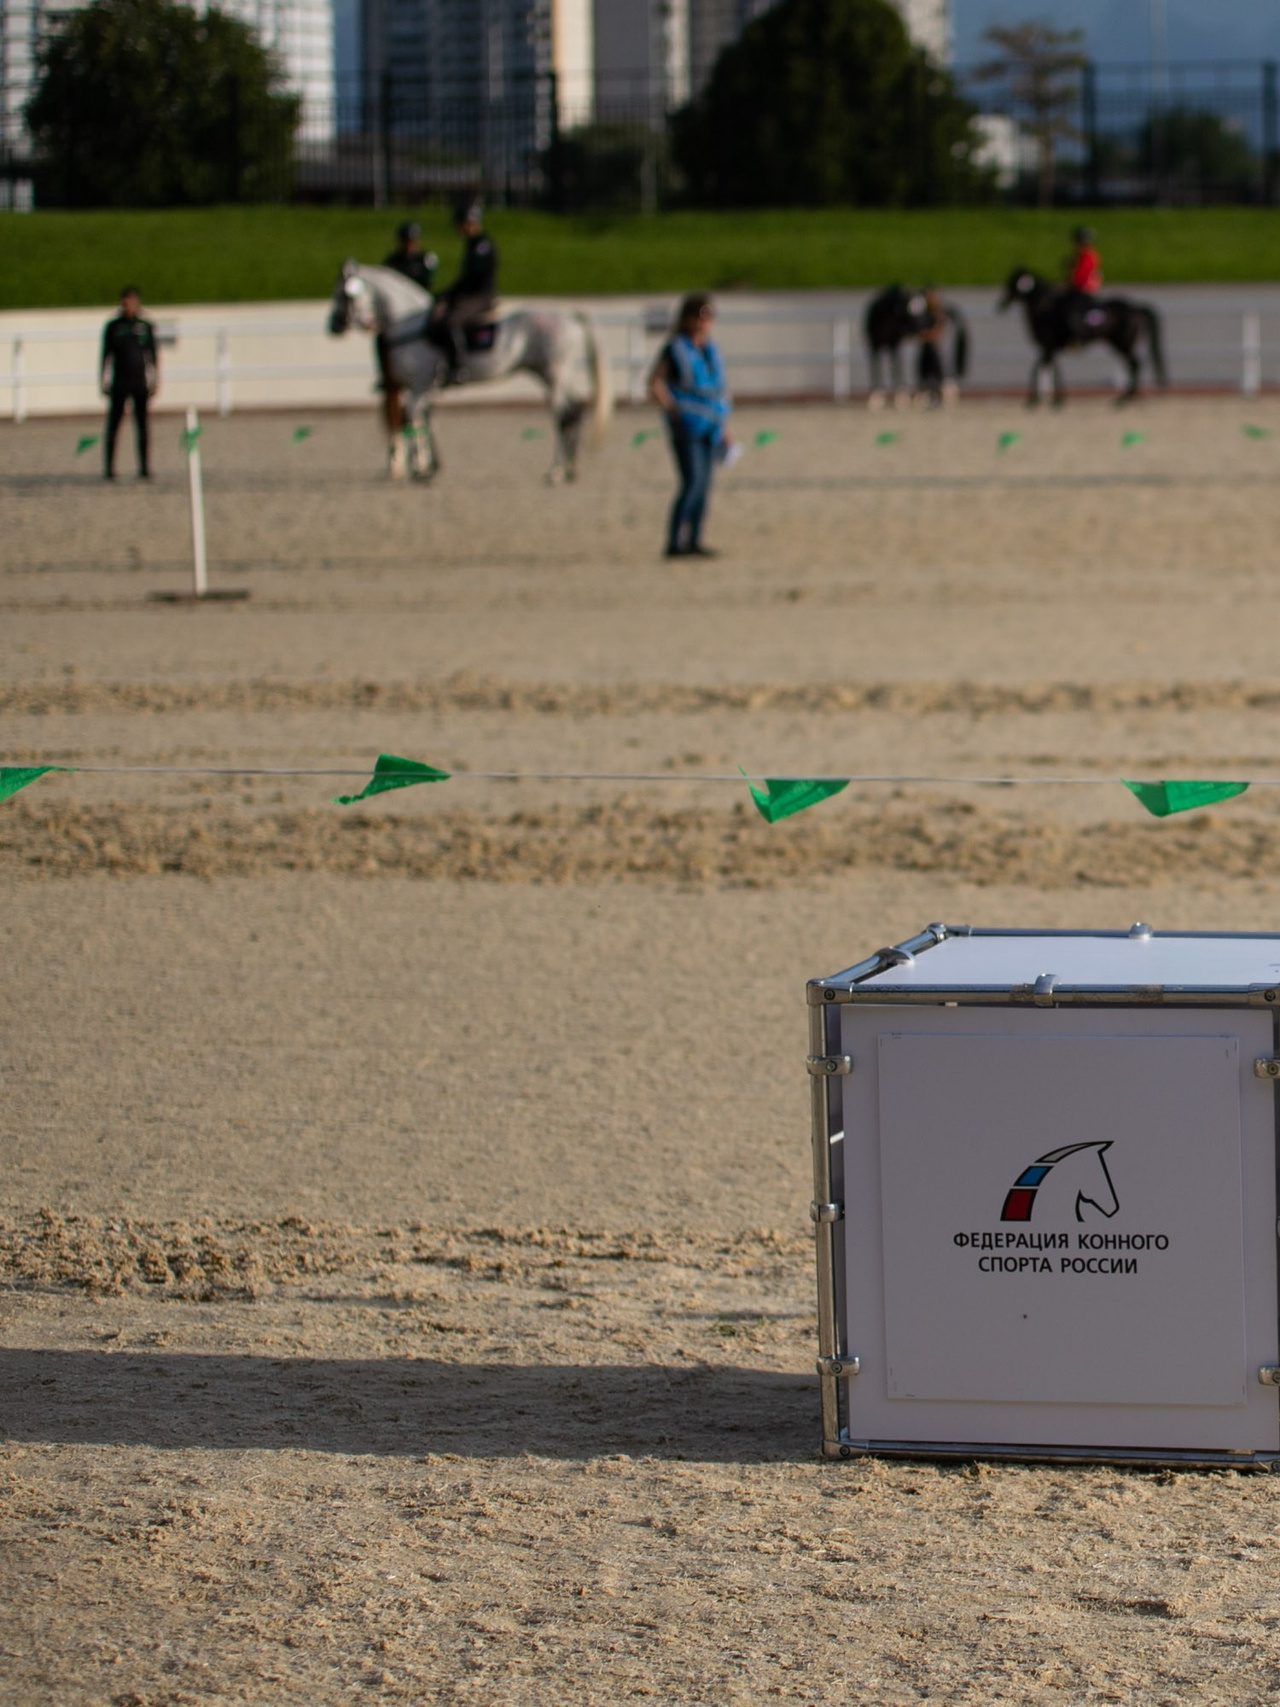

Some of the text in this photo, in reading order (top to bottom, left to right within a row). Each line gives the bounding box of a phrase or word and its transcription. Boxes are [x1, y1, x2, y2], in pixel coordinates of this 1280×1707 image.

[953, 1232, 1169, 1251] ФЕДЕРАЦИЯ КОННОГО
[978, 1256, 1138, 1274] СПОРТА РОССИИ
